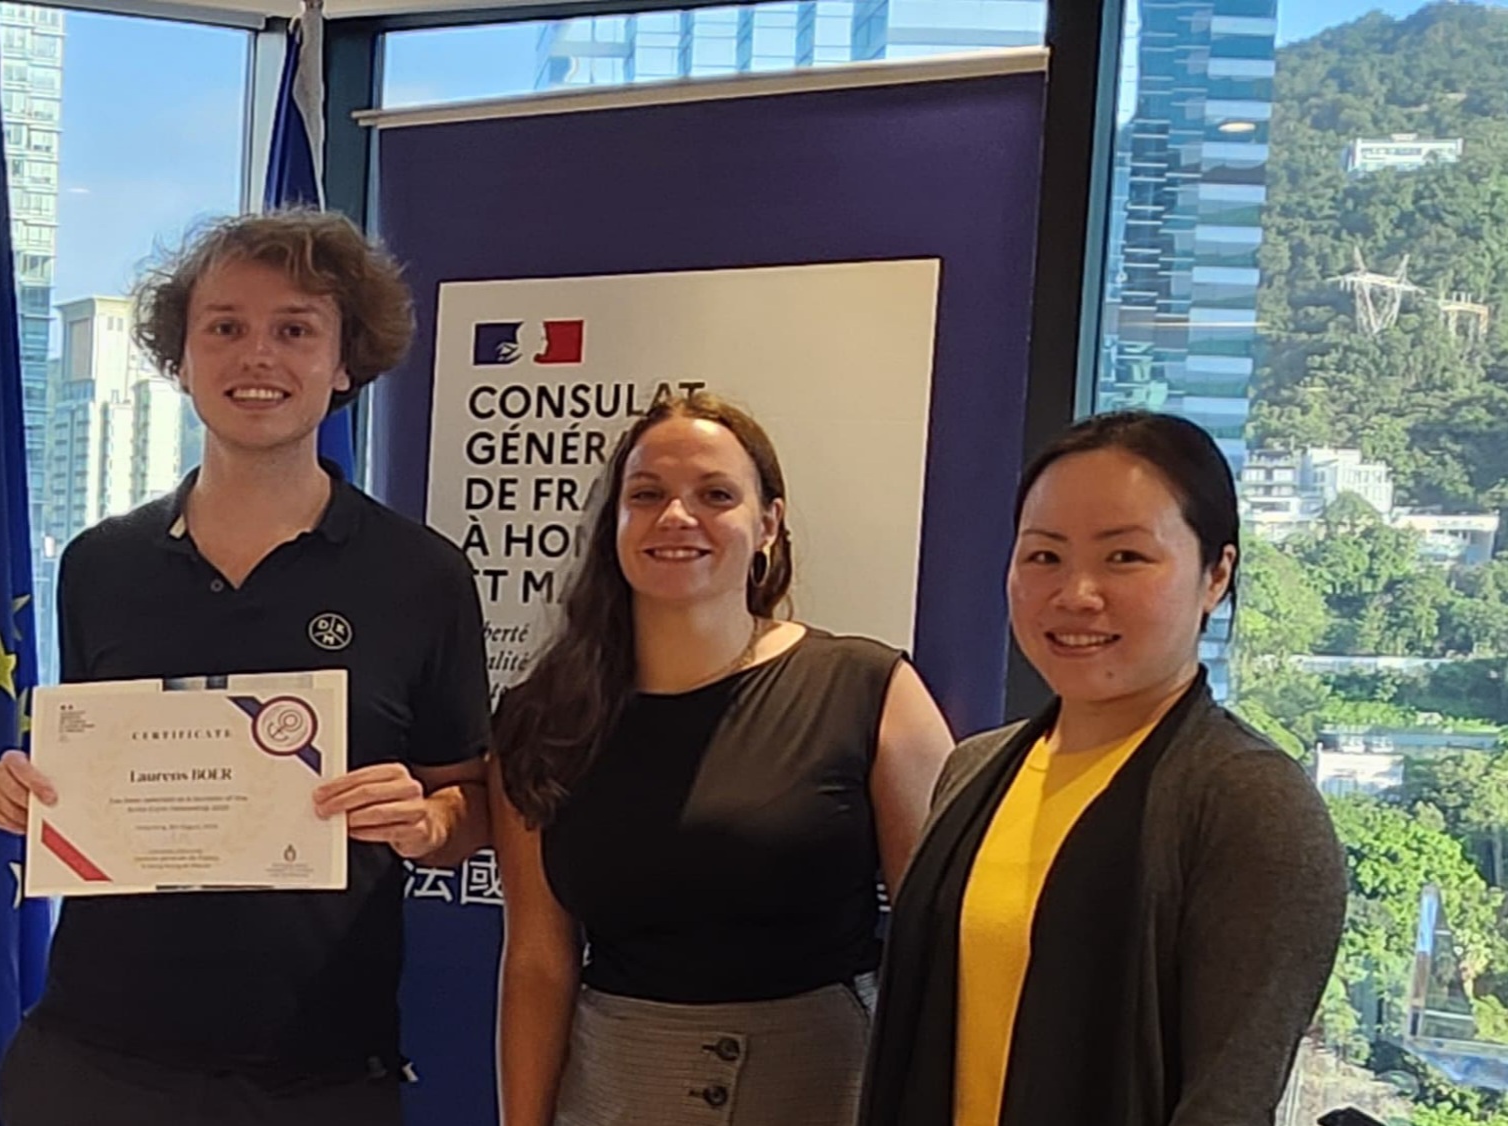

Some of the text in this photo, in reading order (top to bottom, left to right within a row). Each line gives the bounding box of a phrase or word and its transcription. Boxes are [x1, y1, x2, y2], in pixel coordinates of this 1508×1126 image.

[466, 422, 608, 465] GÉNÉR
[466, 478, 518, 511] DE
[462, 514, 577, 558] À HO
[473, 569, 509, 602] T
[483, 620, 530, 642] berté
[133, 729, 230, 740] CERTIFICATE
[130, 770, 189, 783] Laurens
